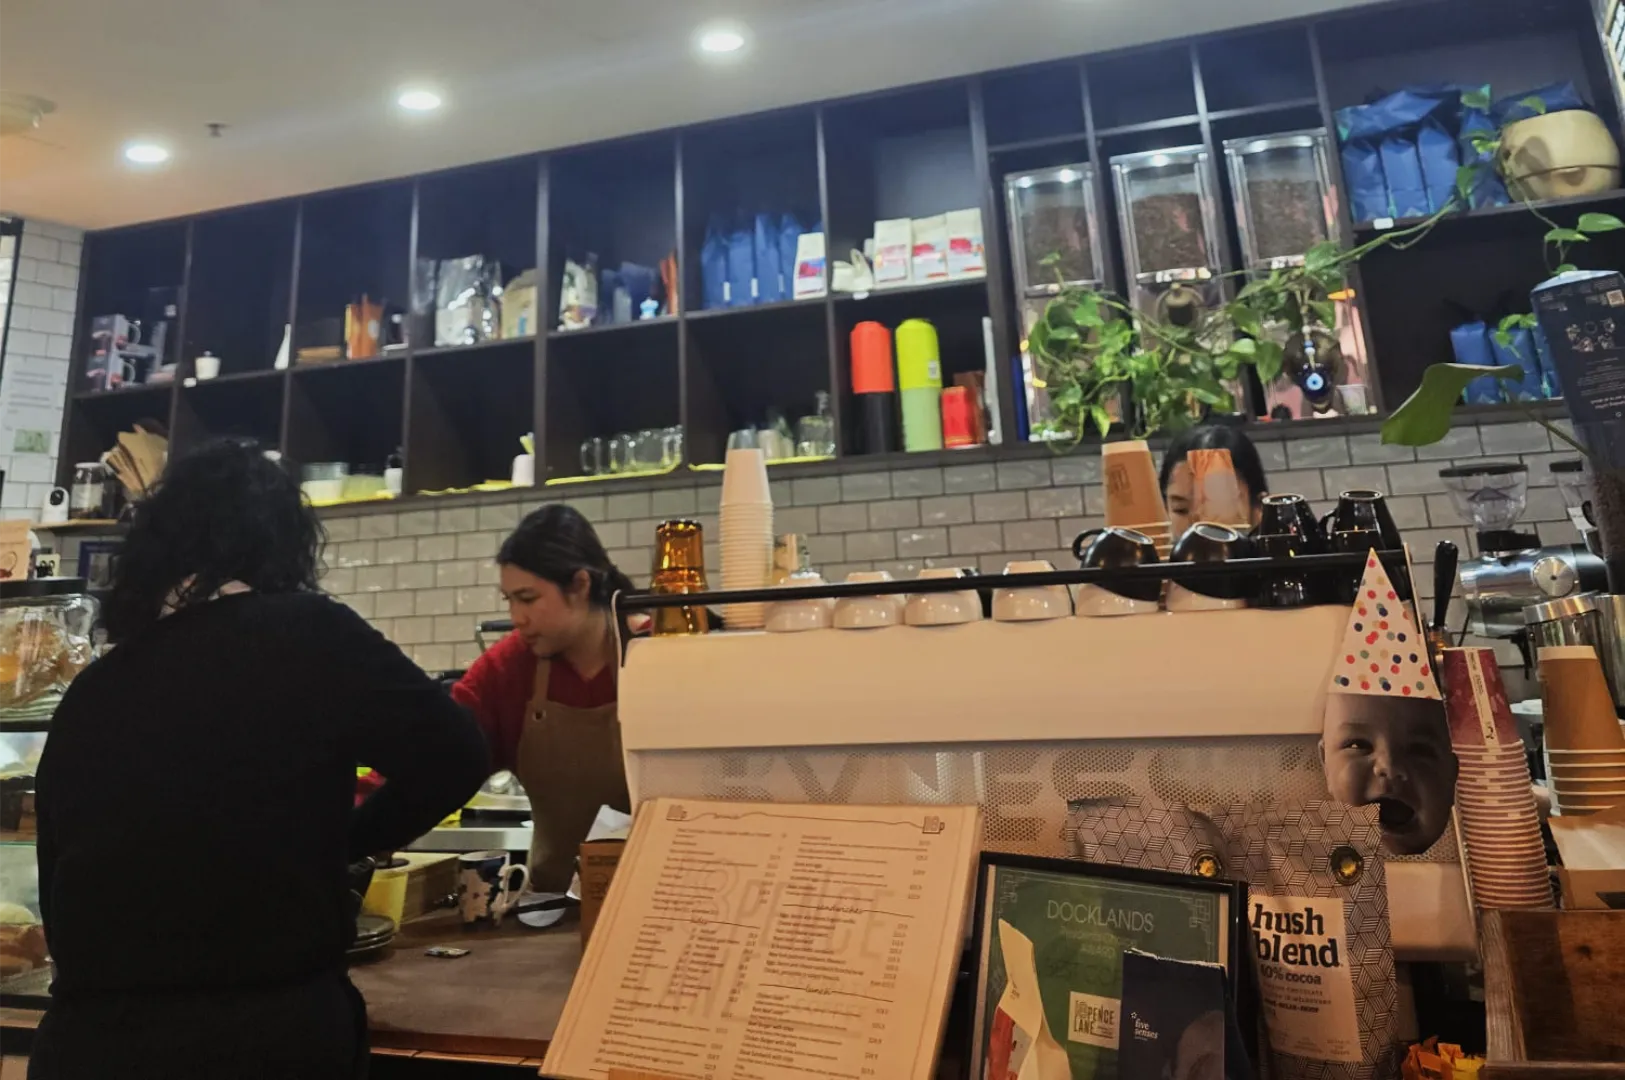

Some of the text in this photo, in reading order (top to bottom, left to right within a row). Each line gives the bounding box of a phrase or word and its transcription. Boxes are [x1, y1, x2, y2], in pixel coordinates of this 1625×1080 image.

[1047, 900, 1155, 933] DOCKLANDS
[1252, 903, 1324, 936] hush
[1286, 972, 1322, 985] cocoa
